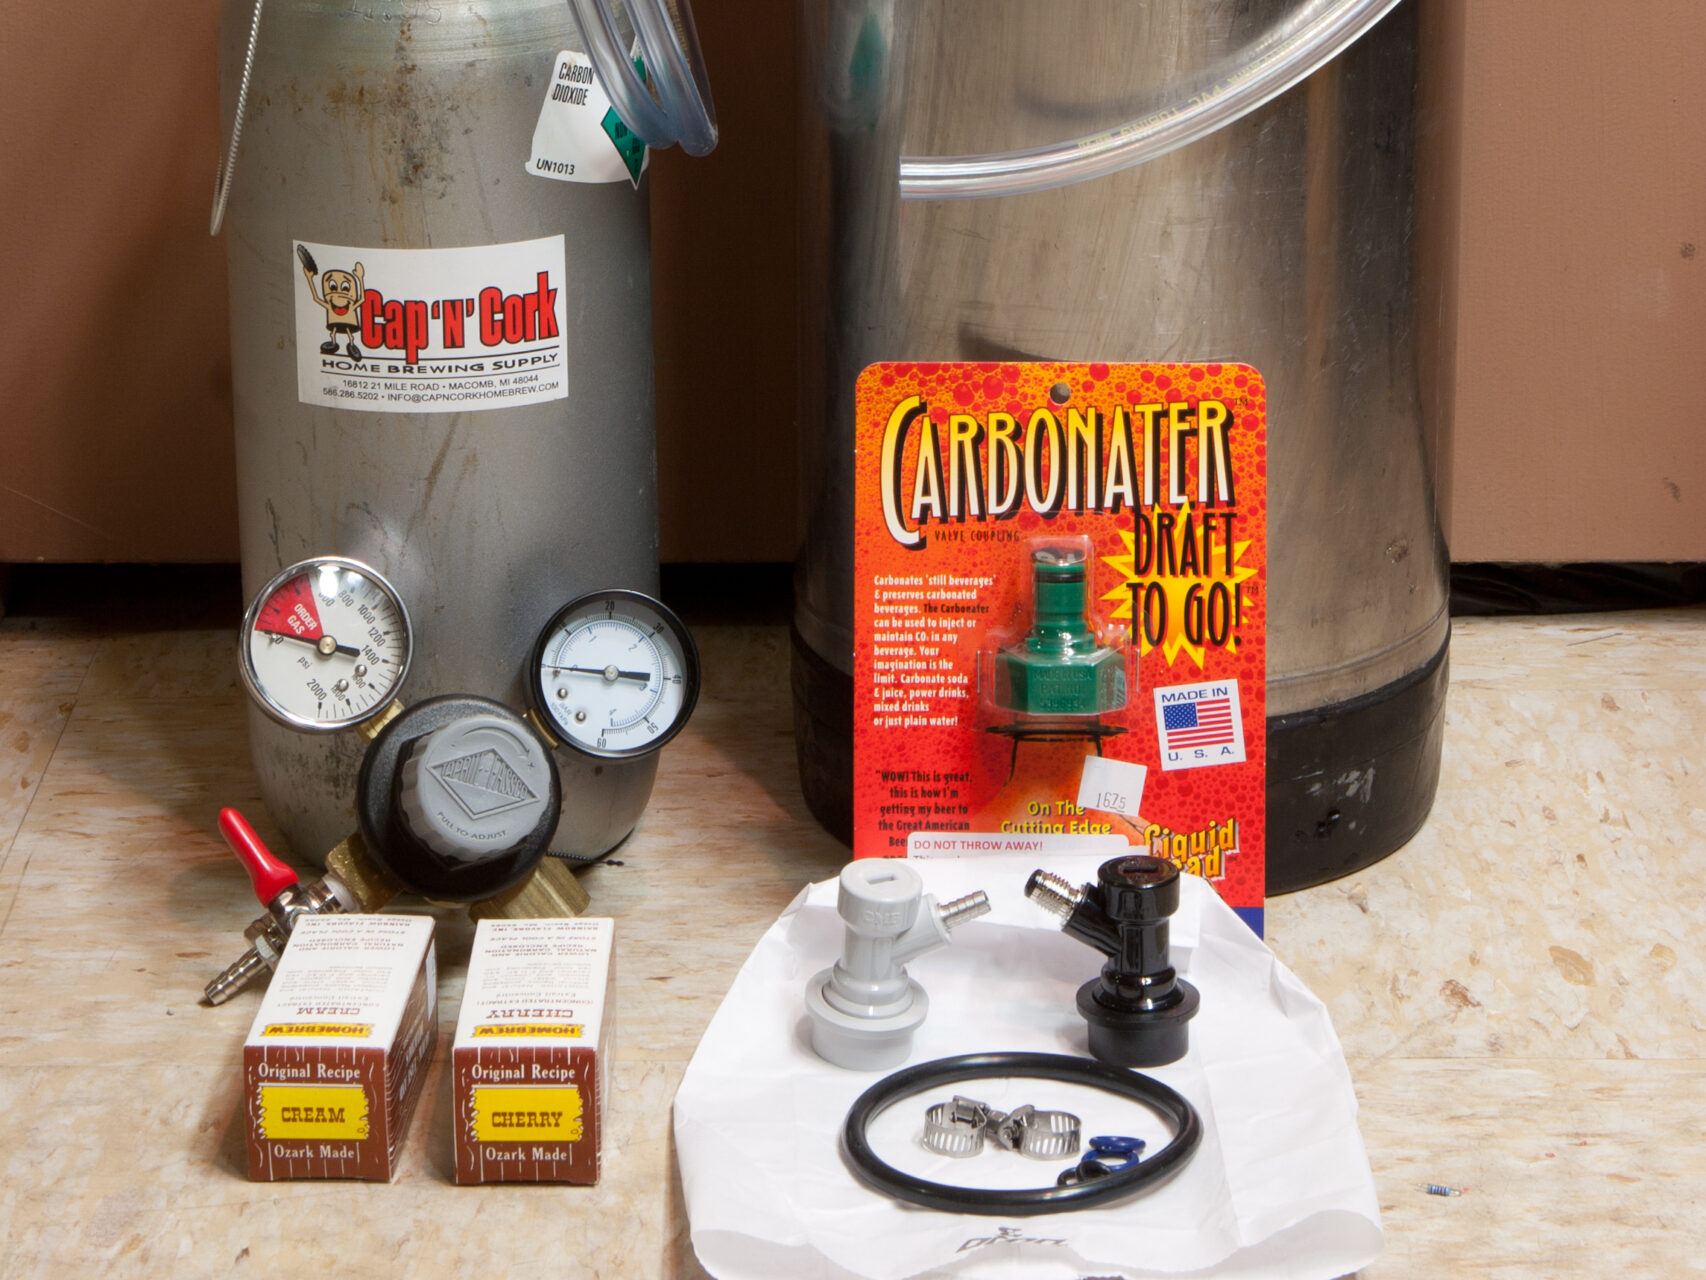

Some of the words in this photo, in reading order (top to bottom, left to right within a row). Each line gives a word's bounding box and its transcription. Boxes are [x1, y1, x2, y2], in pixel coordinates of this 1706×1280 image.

[558, 62, 594, 85] CARBON
[552, 84, 588, 106] DIOXIDE
[536, 158, 575, 175] UN1013
[361, 289, 429, 365] Cap
[479, 271, 560, 347] Cork
[321, 358, 381, 373] HOME
[388, 362, 485, 375] BREWING
[492, 353, 559, 372] SUPPLY
[371, 382, 381, 390] 21
[384, 382, 408, 391] MILE
[410, 382, 440, 392] ROAD
[500, 378, 511, 388] MI
[513, 375, 539, 385] 48044
[387, 381, 560, 403] INFO@CAPNCORKHOMEBREW.COM
[880, 395, 1236, 549] CARBONATER
[935, 530, 965, 541] VALVE
[971, 530, 1019, 542] COUPLING
[1134, 513, 1238, 577] DRAFT
[874, 575, 923, 586] Carbonates
[338, 590, 354, 607] 800
[882, 590, 924, 602] preserves
[926, 588, 977, 600] carbonated
[605, 601, 615, 611] 20
[874, 603, 921, 616] beverages.
[923, 604, 938, 613] The
[940, 603, 989, 613] Carbonater
[294, 603, 317, 631] ORDER
[358, 604, 376, 625] 1000
[1126, 581, 1167, 647] TO
[1184, 581, 1242, 647] GO!
[287, 615, 305, 634] GAS
[653, 622, 664, 634] 30
[874, 619, 890, 628] can
[892, 616, 903, 628] be
[905, 616, 925, 628] used
[927, 618, 937, 628] to
[939, 617, 965, 630] inject
[967, 620, 976, 628] or
[368, 627, 386, 648] 1200
[874, 631, 913, 642] maintain
[931, 631, 940, 642] in
[942, 633, 958, 645] any
[362, 645, 380, 666] 1400
[874, 645, 917, 658] beverage.
[919, 646, 940, 656] Your
[297, 656, 312, 669] psi
[874, 659, 927, 672] imagination
[929, 660, 937, 670] is
[939, 659, 953, 670] the
[874, 673, 898, 684] limit.
[900, 673, 945, 684] Carbonate
[947, 673, 968, 684] soda
[307, 678, 327, 701] 2000
[882, 687, 907, 700] juice,
[909, 690, 937, 700] power
[938, 687, 969, 699] drinks,
[1161, 689, 1209, 703] MADE
[1212, 687, 1229, 697] IN
[874, 701, 900, 712] mixed
[902, 701, 930, 712] drinks
[647, 721, 659, 734] 50
[873, 717, 883, 726] or
[885, 715, 902, 728] just
[904, 715, 928, 728] plain
[930, 716, 959, 726] water!
[596, 738, 607, 749] 60
[1168, 751, 1182, 761] U.
[1194, 748, 1208, 759] S.
[1220, 746, 1234, 755] A.
[912, 771, 930, 782] This
[933, 771, 941, 782] is
[944, 772, 973, 785] great,
[890, 787, 908, 798] this
[910, 787, 918, 798] is
[921, 787, 940, 798] how
[943, 786, 959, 798] I'm
[880, 803, 915, 817] getting
[918, 806, 932, 817] my
[934, 803, 956, 814] beer
[958, 804, 968, 814] to
[1027, 801, 1051, 816] On
[1055, 800, 1086, 816] The
[437, 812, 454, 830] PULL
[456, 827, 469, 837] TO
[471, 830, 507, 840] ADJUST
[878, 819, 894, 830] the
[896, 819, 922, 831] Great
[925, 819, 970, 830] American
[1000, 820, 1065, 835] Cutting
[1069, 820, 1112, 835] Edge
[914, 840, 930, 850] DO
[933, 840, 957, 851] NOT
[960, 840, 1002, 851] THROW
[1004, 840, 1043, 851] AWAY!
[1143, 817, 1240, 864] Liquid
[268, 1025, 364, 1034] HOMEBREW
[479, 1026, 575, 1035] HOMEBREW
[258, 1063, 311, 1080] Original
[317, 1063, 361, 1081] Recipe
[471, 1063, 525, 1081] Original
[531, 1063, 576, 1081] Recipe
[281, 1107, 346, 1124] CREAM
[492, 1111, 564, 1129] CHERRY
[274, 1145, 315, 1159] Ozark
[319, 1145, 355, 1160] Made
[485, 1146, 527, 1161] Ozark
[532, 1146, 568, 1161] Made
